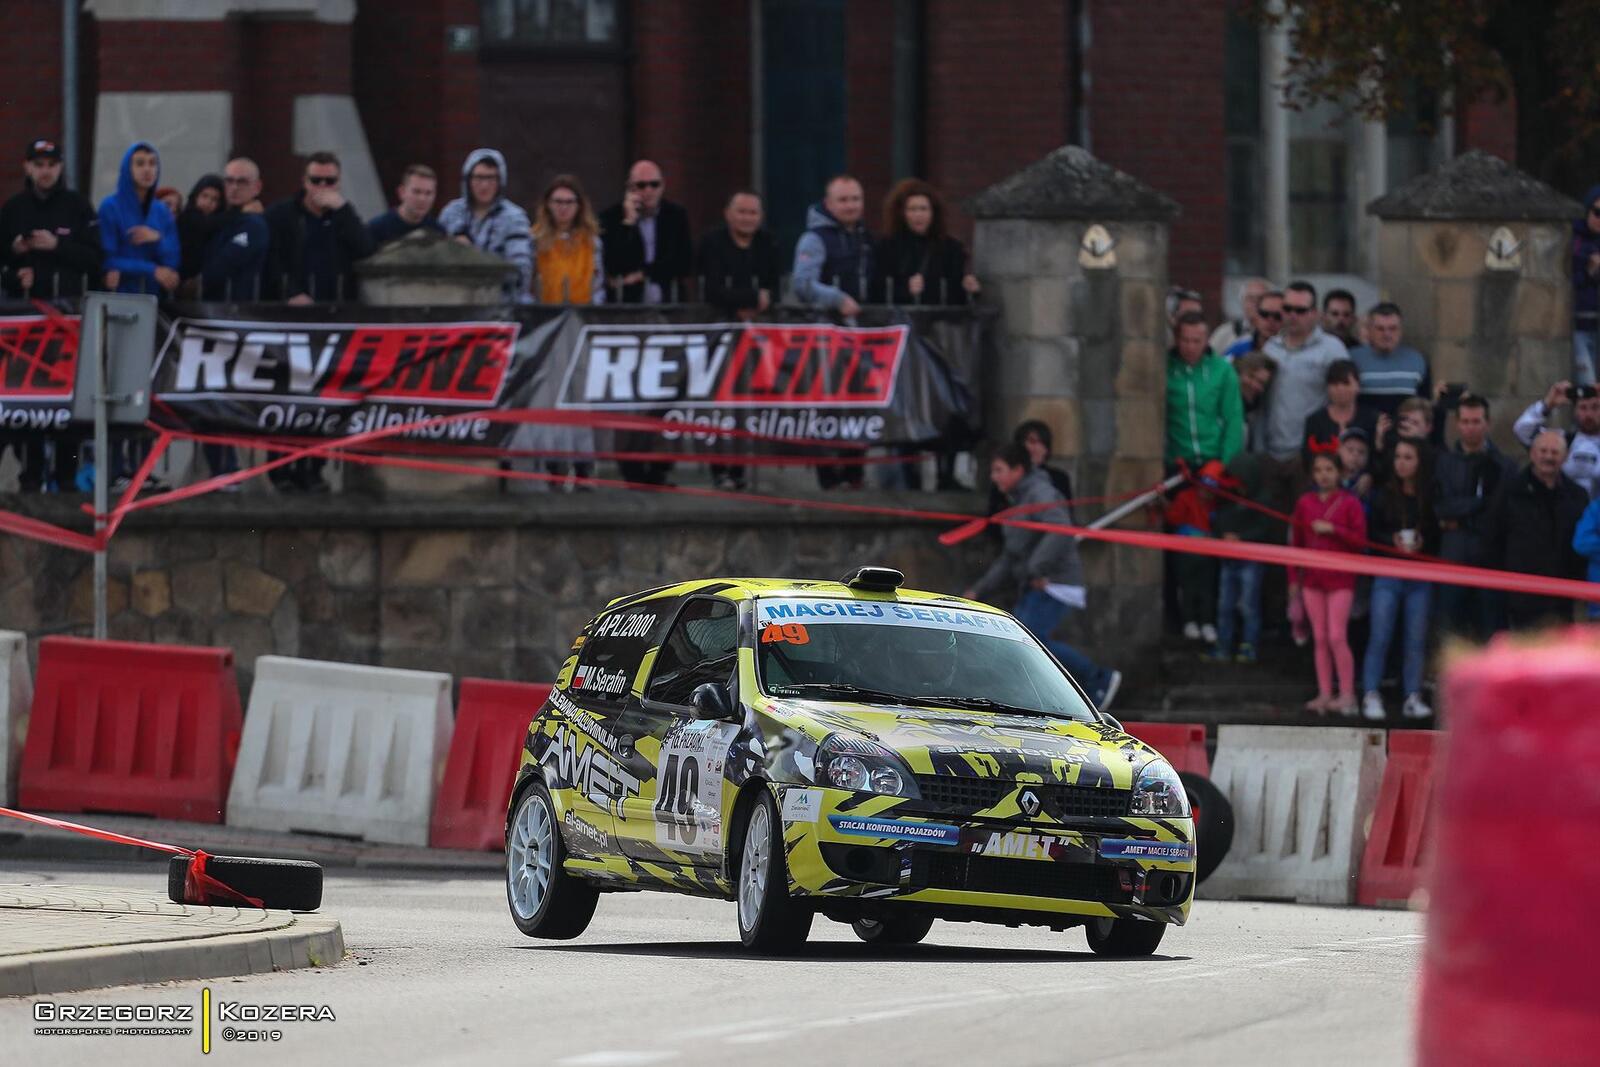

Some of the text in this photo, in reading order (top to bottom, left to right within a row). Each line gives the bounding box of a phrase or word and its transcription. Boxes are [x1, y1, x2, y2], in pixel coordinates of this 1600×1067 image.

[585, 334, 895, 400] REVLINE
[348, 404, 490, 440] silnikowe
[745, 408, 884, 440] silnikowe
[765, 603, 884, 619] MACIEJ
[761, 623, 810, 645] 49
[540, 724, 640, 819] AMET
[838, 820, 946, 838] STACJA KONTROLI POJAZDÓW
[1147, 847, 1169, 856] MACIEJ
